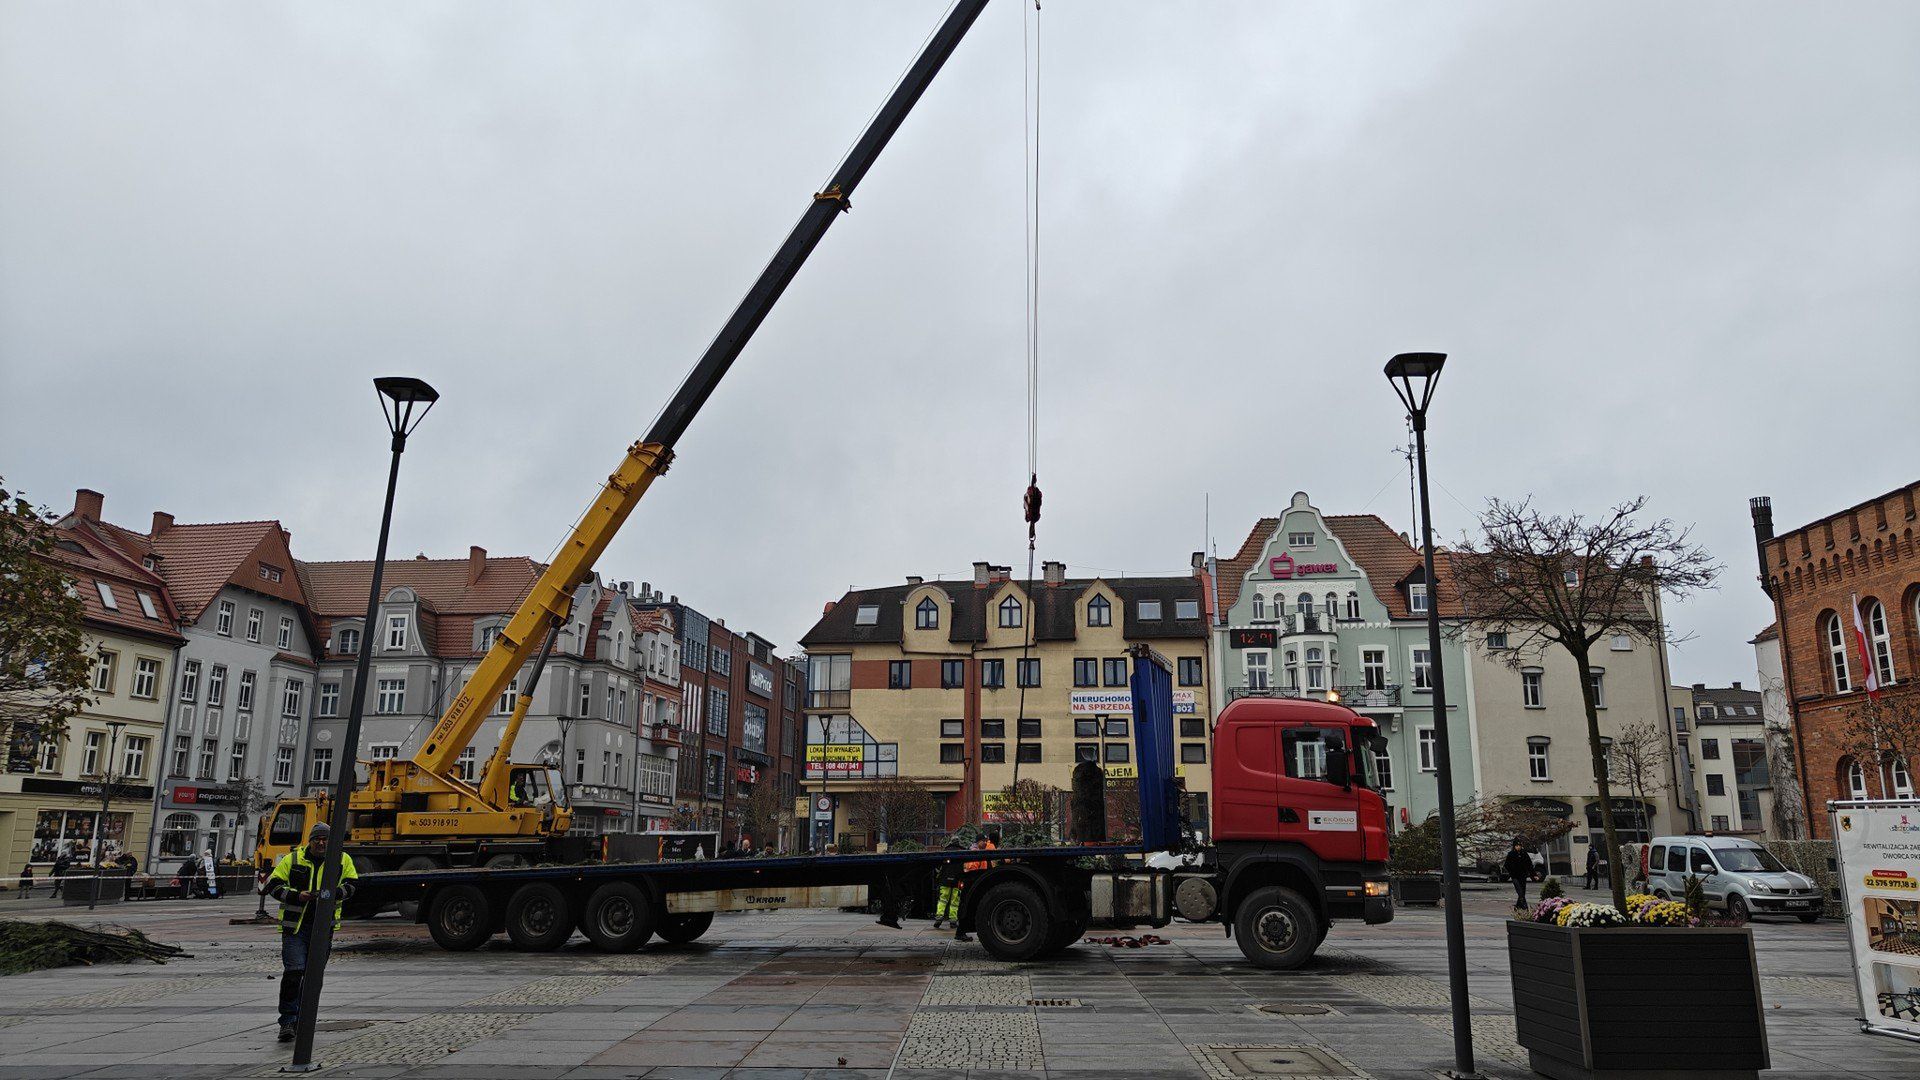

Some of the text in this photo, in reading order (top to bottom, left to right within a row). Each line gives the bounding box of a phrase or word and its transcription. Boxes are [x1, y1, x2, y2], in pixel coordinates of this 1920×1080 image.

[1297, 563, 1338, 576] gawex
[750, 669, 772, 693] HalfPrice
[458, 696, 470, 709] 912
[1176, 705, 1193, 713] 802
[833, 746, 861, 754] WYNAJĘCIA
[837, 762, 848, 770] 407
[1104, 767, 1133, 777] AJEM
[419, 818, 431, 827] 503
[432, 818, 445, 827] 918
[446, 818, 459, 827] 912
[1863, 843, 1909, 851] REWITALIZACJA
[1882, 852, 1910, 860] DWORCA
[1866, 879, 1875, 887] 22
[756, 896, 787, 904] KRONE
